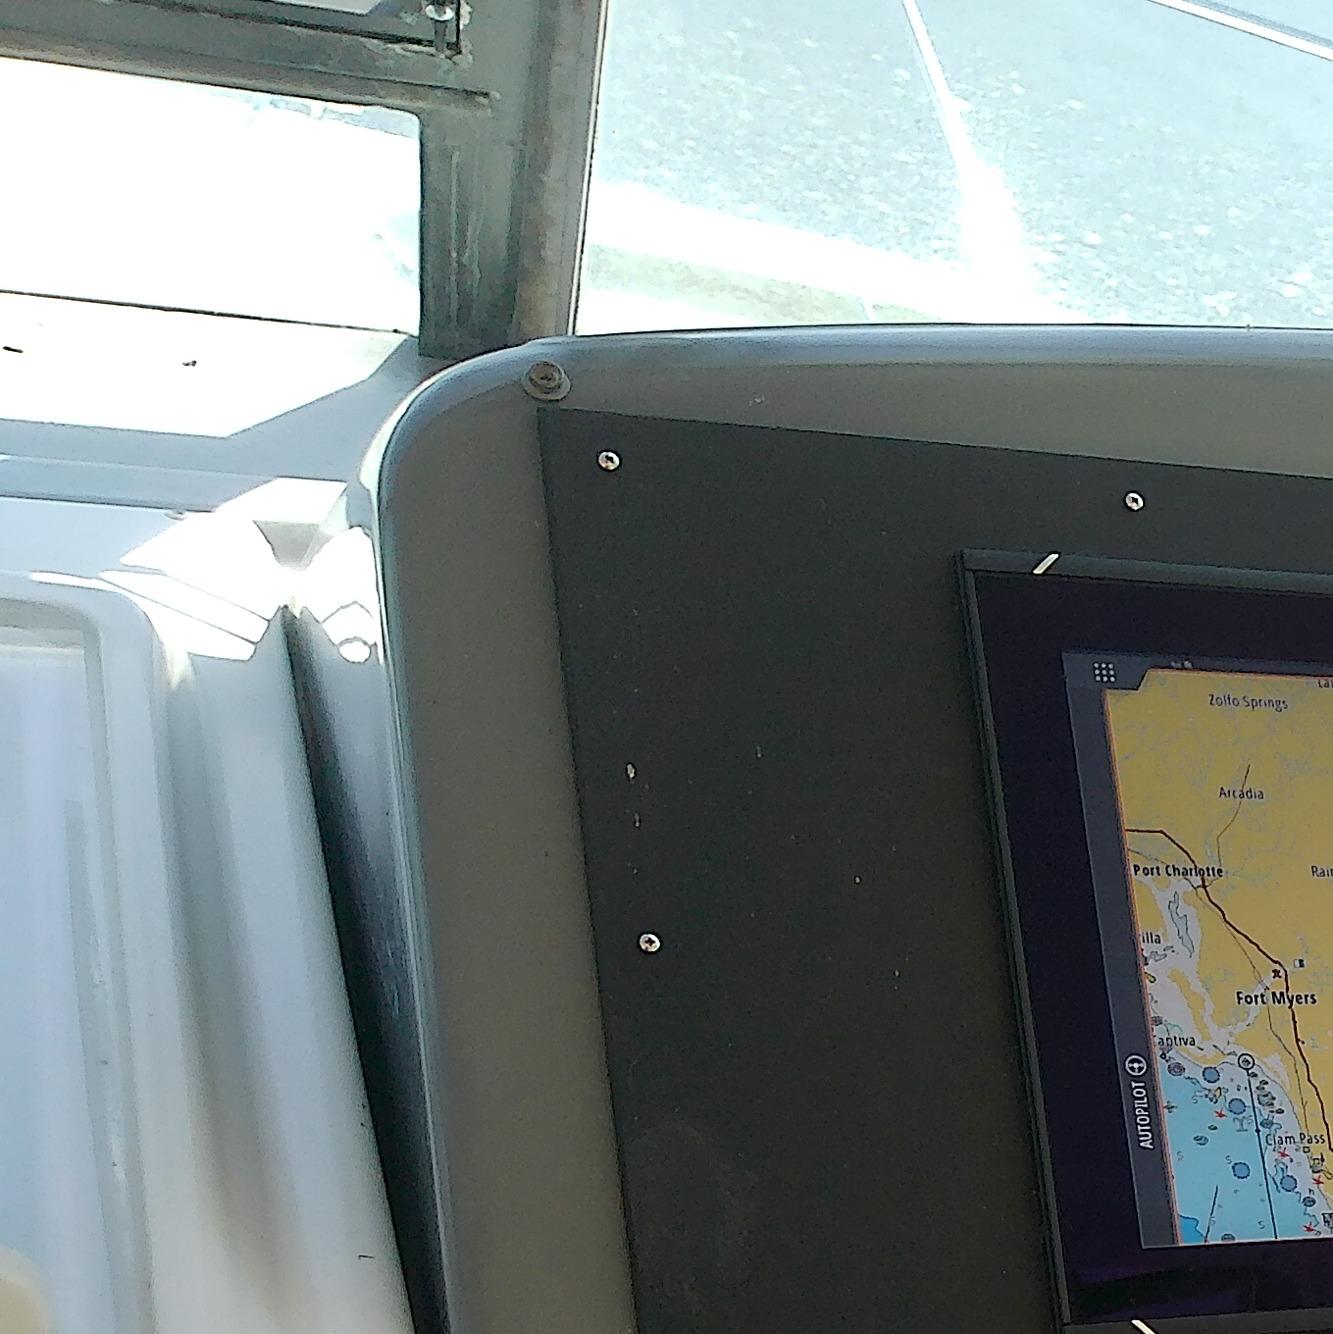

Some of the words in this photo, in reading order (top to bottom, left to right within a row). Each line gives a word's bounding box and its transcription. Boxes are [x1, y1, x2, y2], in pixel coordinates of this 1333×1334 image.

[1243, 696, 1288, 712] Springs
[1219, 787, 1264, 800] Arcadia
[1133, 864, 1161, 877] Port
[1165, 863, 1224, 878] Charlotte
[1236, 992, 1267, 1005] Fort
[1272, 991, 1318, 1009] Myers
[1132, 1080, 1155, 1149] AUTOPILOT
[1265, 1134, 1296, 1146] Clam
[1299, 1132, 1326, 1146] Pass
